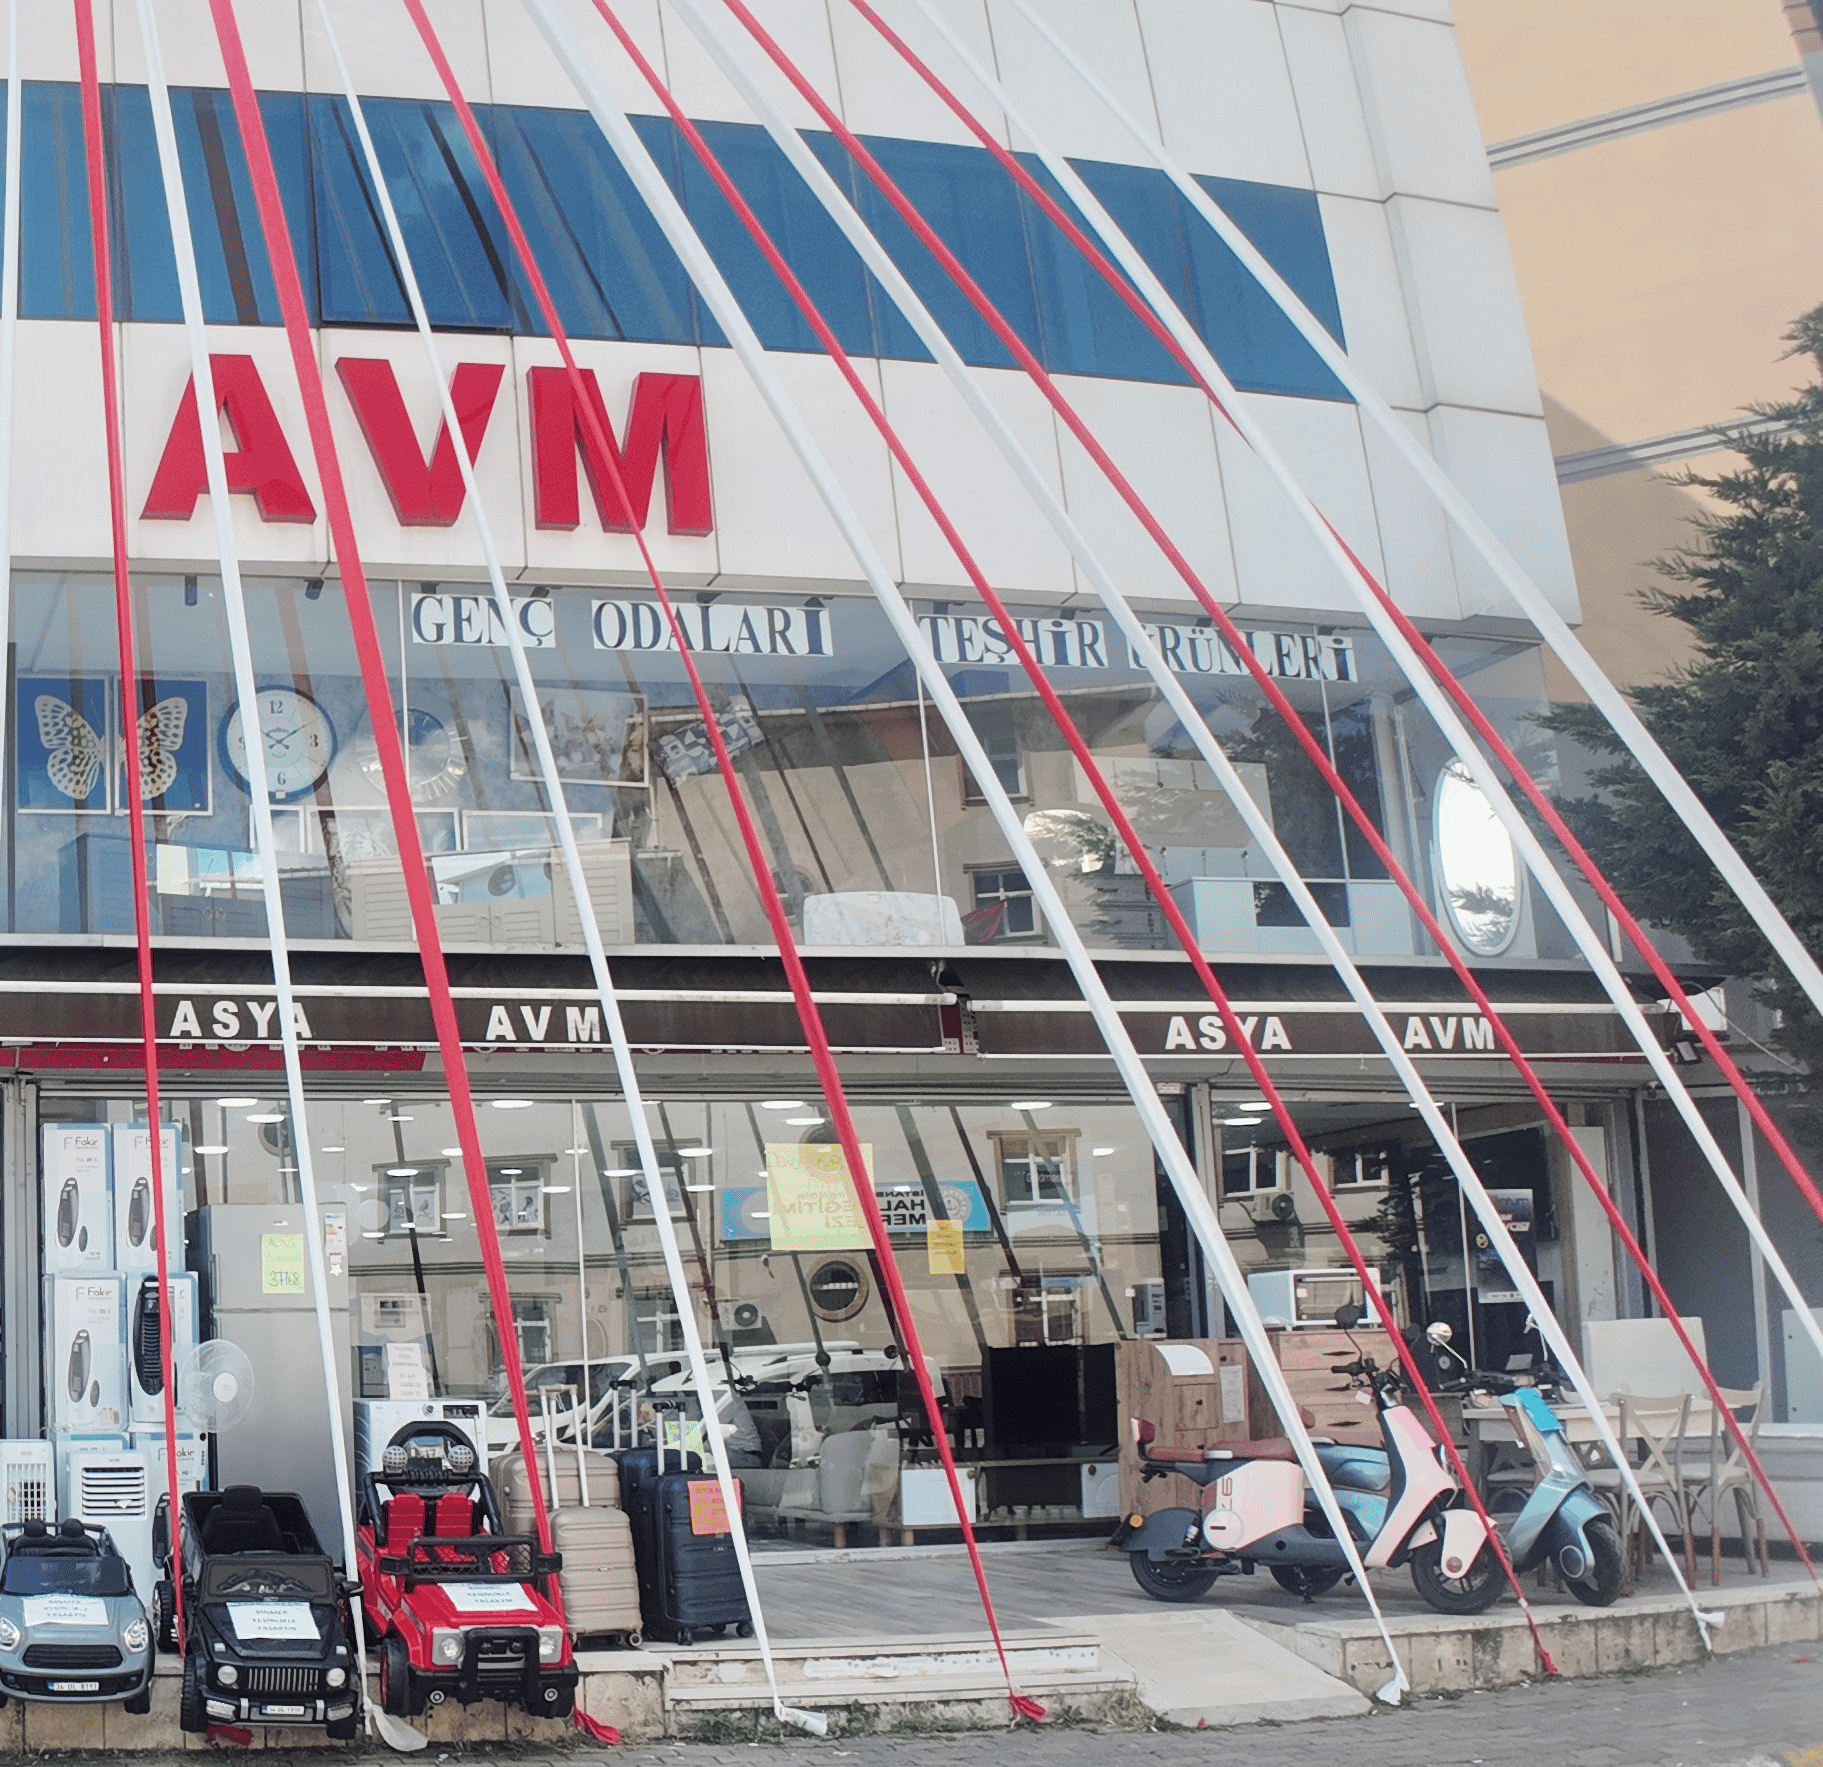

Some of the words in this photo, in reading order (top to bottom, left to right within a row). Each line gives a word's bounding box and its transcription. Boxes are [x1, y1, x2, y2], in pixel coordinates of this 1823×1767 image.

[139, 353, 714, 538] AVM
[412, 596, 556, 647] GENÇ
[919, 615, 1105, 668] TEŞHİR
[270, 700, 283, 714] 12
[170, 1000, 313, 1039] ASYA
[485, 1005, 602, 1042] AVM
[1164, 1015, 1293, 1051] ASYA
[1403, 1015, 1496, 1051] AVM
